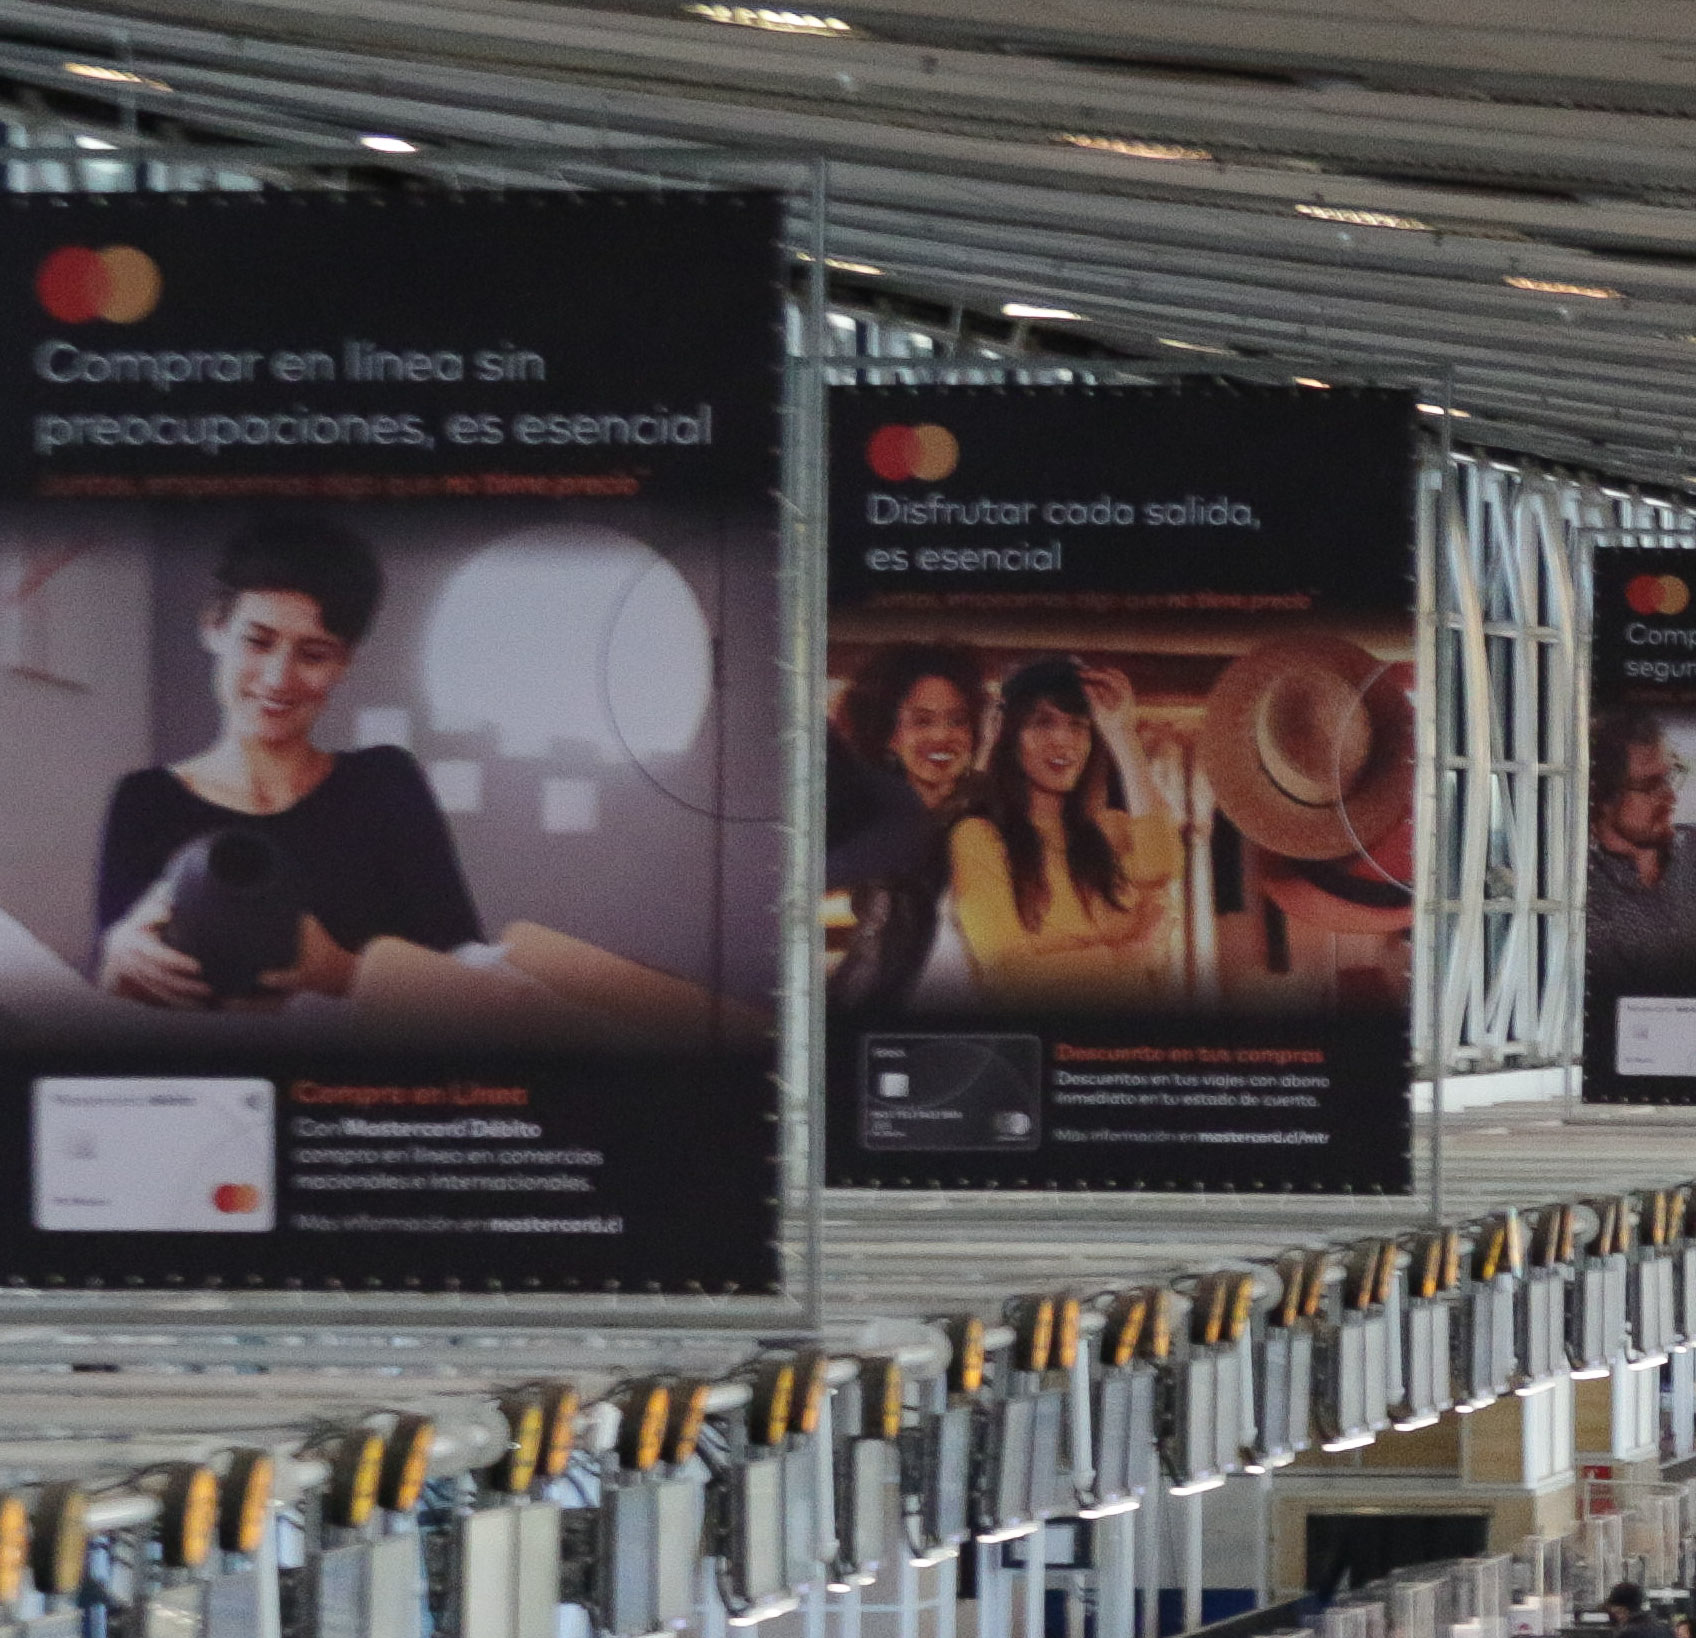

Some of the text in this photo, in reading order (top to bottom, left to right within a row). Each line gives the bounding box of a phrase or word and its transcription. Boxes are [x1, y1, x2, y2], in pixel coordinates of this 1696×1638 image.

[32, 341, 261, 391] Comprar
[269, 352, 335, 383] en
[474, 342, 547, 383] sin
[34, 403, 714, 454] preocupaciones, es esencial
[867, 493, 1262, 530] Disfrutar cada salida,
[866, 540, 1063, 571] es esencial
